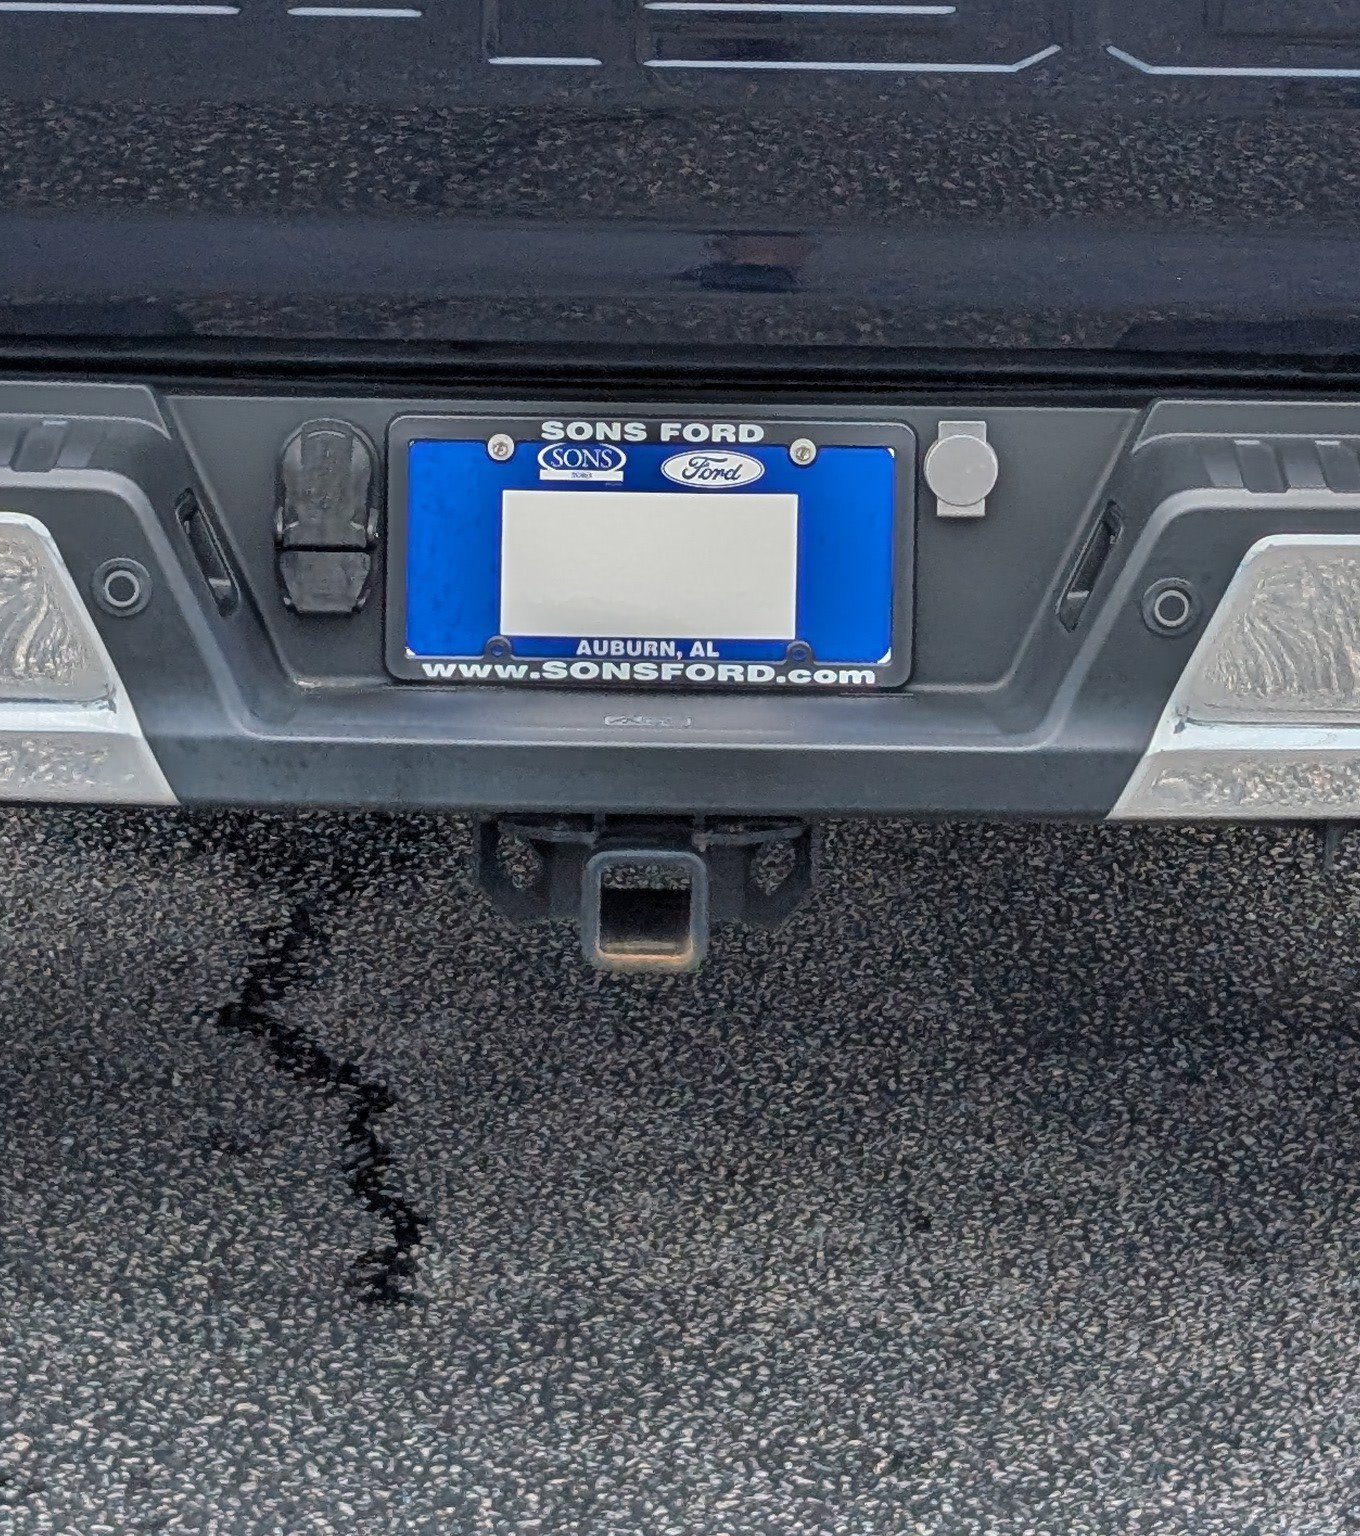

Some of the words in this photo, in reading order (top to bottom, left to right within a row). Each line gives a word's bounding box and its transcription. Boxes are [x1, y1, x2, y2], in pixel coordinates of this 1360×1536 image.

[541, 421, 648, 442] SONS
[660, 422, 765, 443] FORD
[550, 448, 613, 469] SONS
[681, 456, 743, 481] Ford
[575, 639, 683, 660] AUBURN,
[689, 641, 720, 658] AL
[421, 661, 876, 685] www.SONSFORD.com
